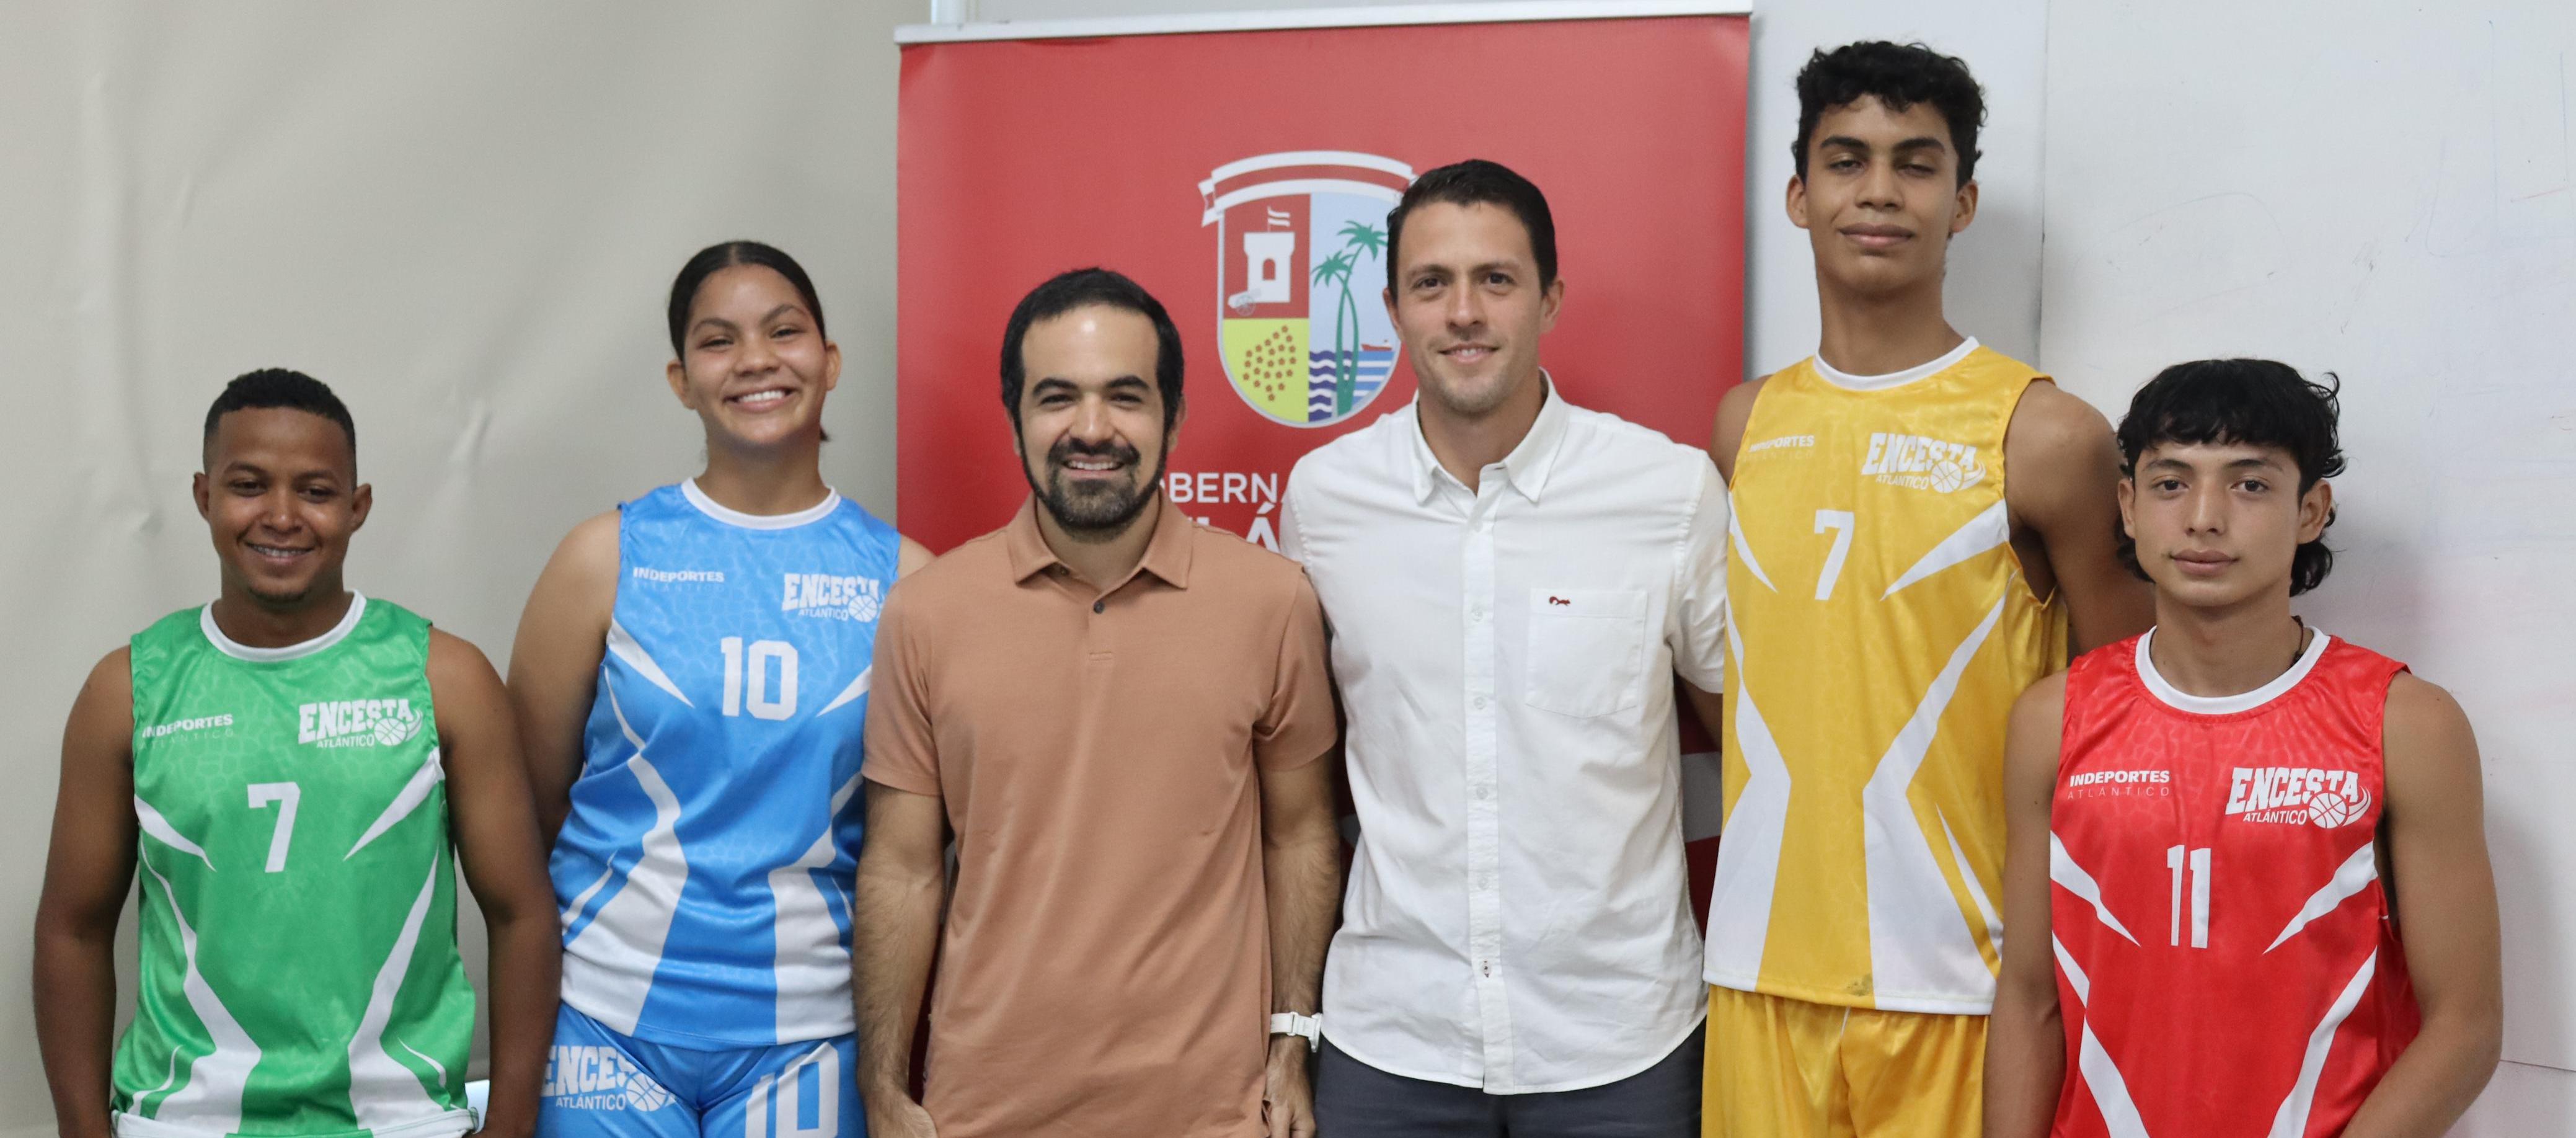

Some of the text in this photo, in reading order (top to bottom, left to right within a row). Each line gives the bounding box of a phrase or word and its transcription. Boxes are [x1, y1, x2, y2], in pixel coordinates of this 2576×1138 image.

[1861, 433, 1977, 475] ENCESTA
[1159, 473, 1283, 504] BERN
[633, 567, 725, 583] INDEPORTES
[1814, 509, 1854, 601] 7
[720, 636, 799, 721] 10
[142, 714, 234, 738] INDEPORTES
[298, 698, 414, 744] ENCESTA
[2069, 770, 2170, 788] INDEPORTES
[2225, 767, 2359, 815] ENCESTA
[247, 781, 301, 873] 7
[2242, 809, 2308, 825] ATLÁNTICO
[2167, 845, 2211, 948] 11
[540, 1044, 637, 1097] ENCES
[745, 1041, 839, 1138] 10
[555, 1093, 627, 1111] ATLÁNTICO
